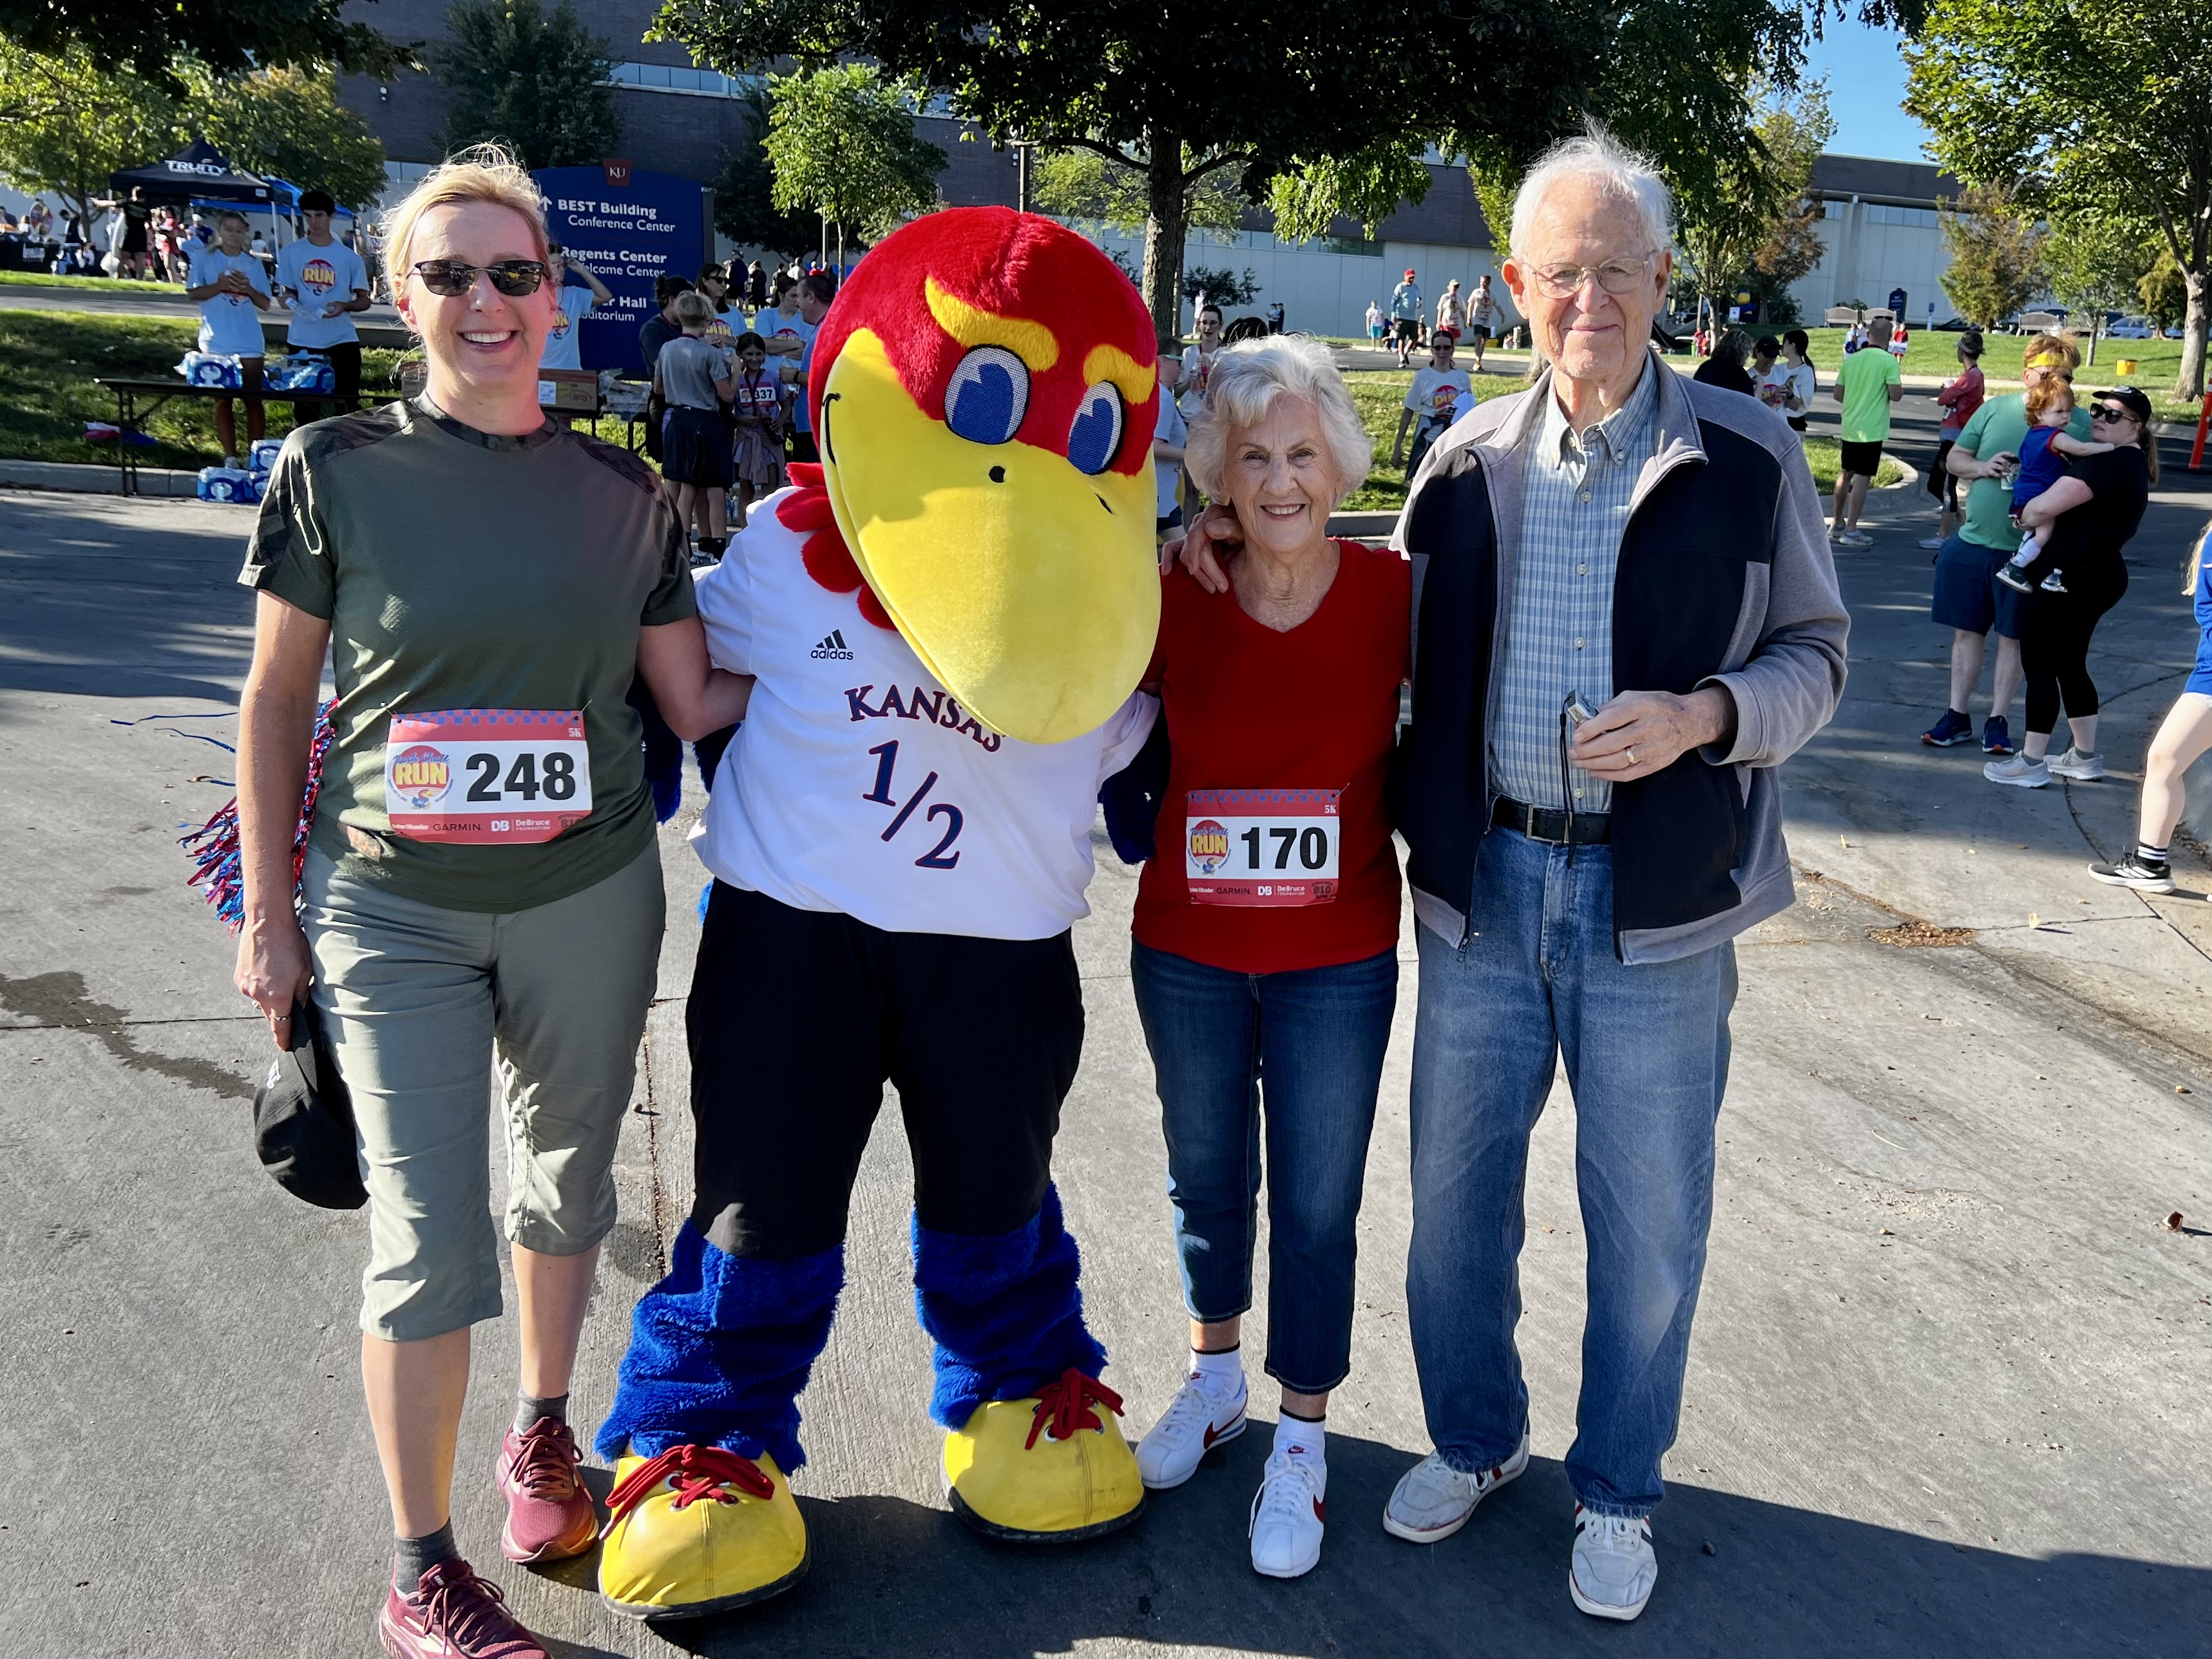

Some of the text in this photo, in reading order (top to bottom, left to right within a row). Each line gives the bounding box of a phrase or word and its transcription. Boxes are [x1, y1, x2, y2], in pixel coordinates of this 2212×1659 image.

[164, 160, 227, 174] TRUITY
[609, 167, 625, 178] KU
[558, 199, 657, 220] BEST Building
[568, 215, 675, 232] Conference Center
[560, 246, 667, 264] Regents Center
[304, 268, 334, 284] RUN
[627, 265, 665, 277] Center
[620, 296, 647, 308] Hall
[810, 647, 853, 660] adidas
[568, 727, 582, 738] 5K
[395, 762, 447, 785] RUN
[466, 752, 576, 802] 248
[863, 740, 964, 869] 1/2
[1324, 805, 1337, 814] 5K
[491, 820, 510, 832] DB
[1192, 834, 1226, 854] RUN
[1241, 827, 1328, 869] 170
[1257, 885, 1272, 896] DB
[1313, 885, 1331, 894] 810
